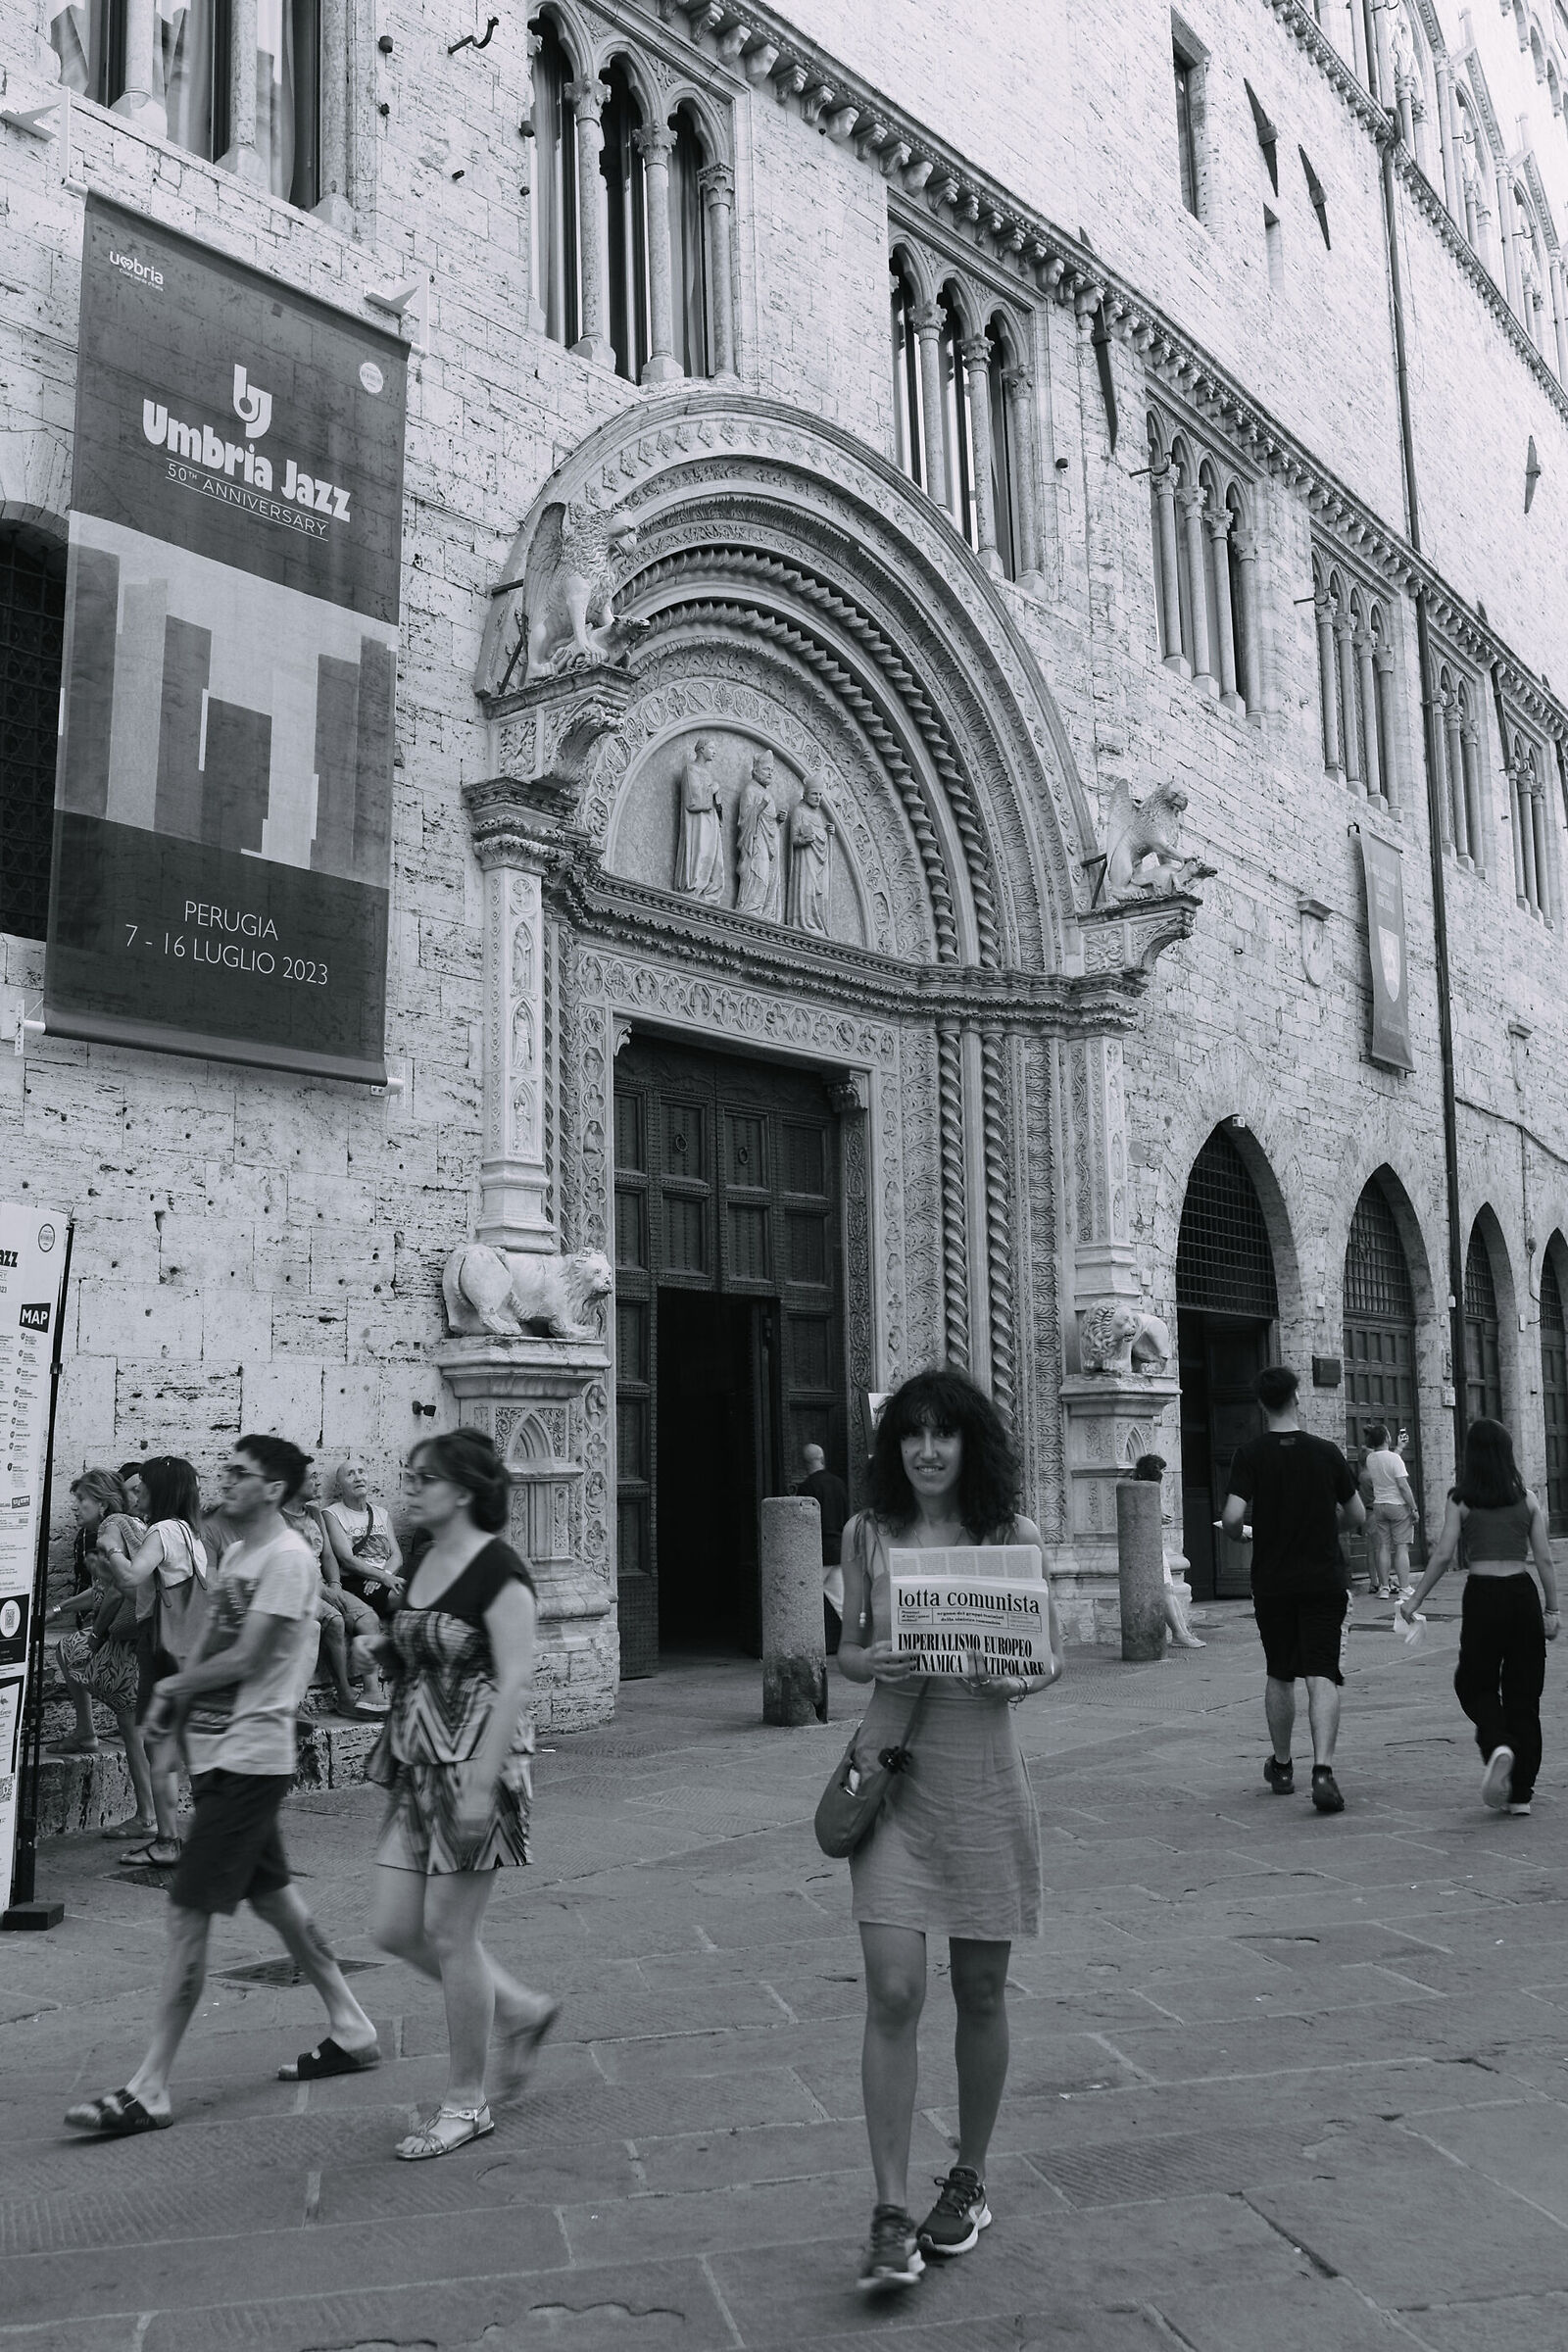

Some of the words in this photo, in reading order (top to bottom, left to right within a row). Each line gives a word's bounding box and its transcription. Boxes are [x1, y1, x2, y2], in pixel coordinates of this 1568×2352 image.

[142, 399, 273, 492] Umbria
[281, 459, 351, 522] Jazz
[203, 478, 326, 536] ANNIVERSARY
[184, 900, 278, 942] PERUGIA
[124, 924, 138, 948] 7
[164, 933, 185, 957] 16
[194, 938, 275, 974] LUGLIO
[282, 956, 328, 986] 2023
[0, 1249, 19, 1268] azz
[21, 1308, 48, 1326] MAP
[898, 1589, 940, 1607] lotta
[947, 1590, 1041, 1614] comunista
[898, 1633, 981, 1651] IMPERIALISMO
[984, 1636, 1032, 1658] EUROPEO
[984, 1656, 1046, 1677] LTIPOLARE
